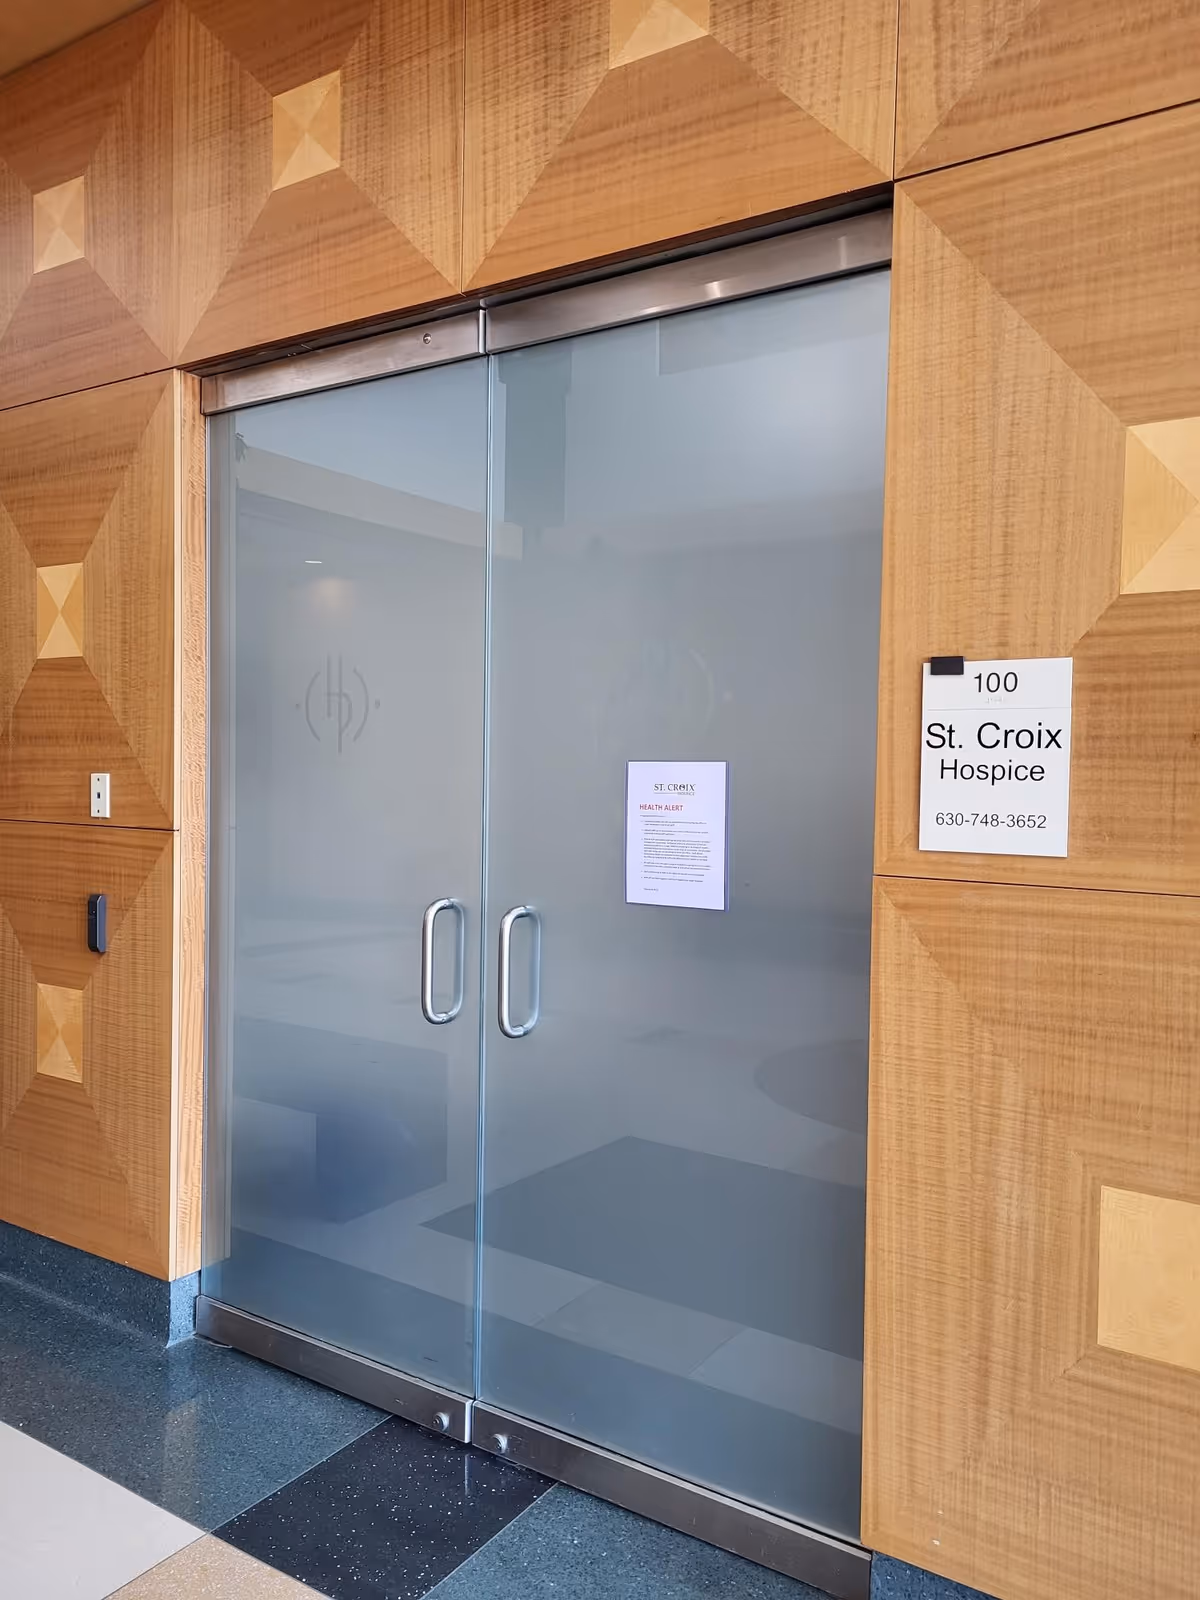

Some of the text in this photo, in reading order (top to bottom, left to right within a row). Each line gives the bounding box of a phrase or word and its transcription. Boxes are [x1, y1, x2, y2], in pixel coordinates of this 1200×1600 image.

[974, 671, 1018, 693] 100
[925, 721, 1063, 749] St. Croix
[940, 758, 1045, 786] Hospice
[653, 783, 696, 792] ST. CROIX
[639, 803, 684, 812] HEALTH ALERT
[935, 812, 1048, 829] 630-748-3652
